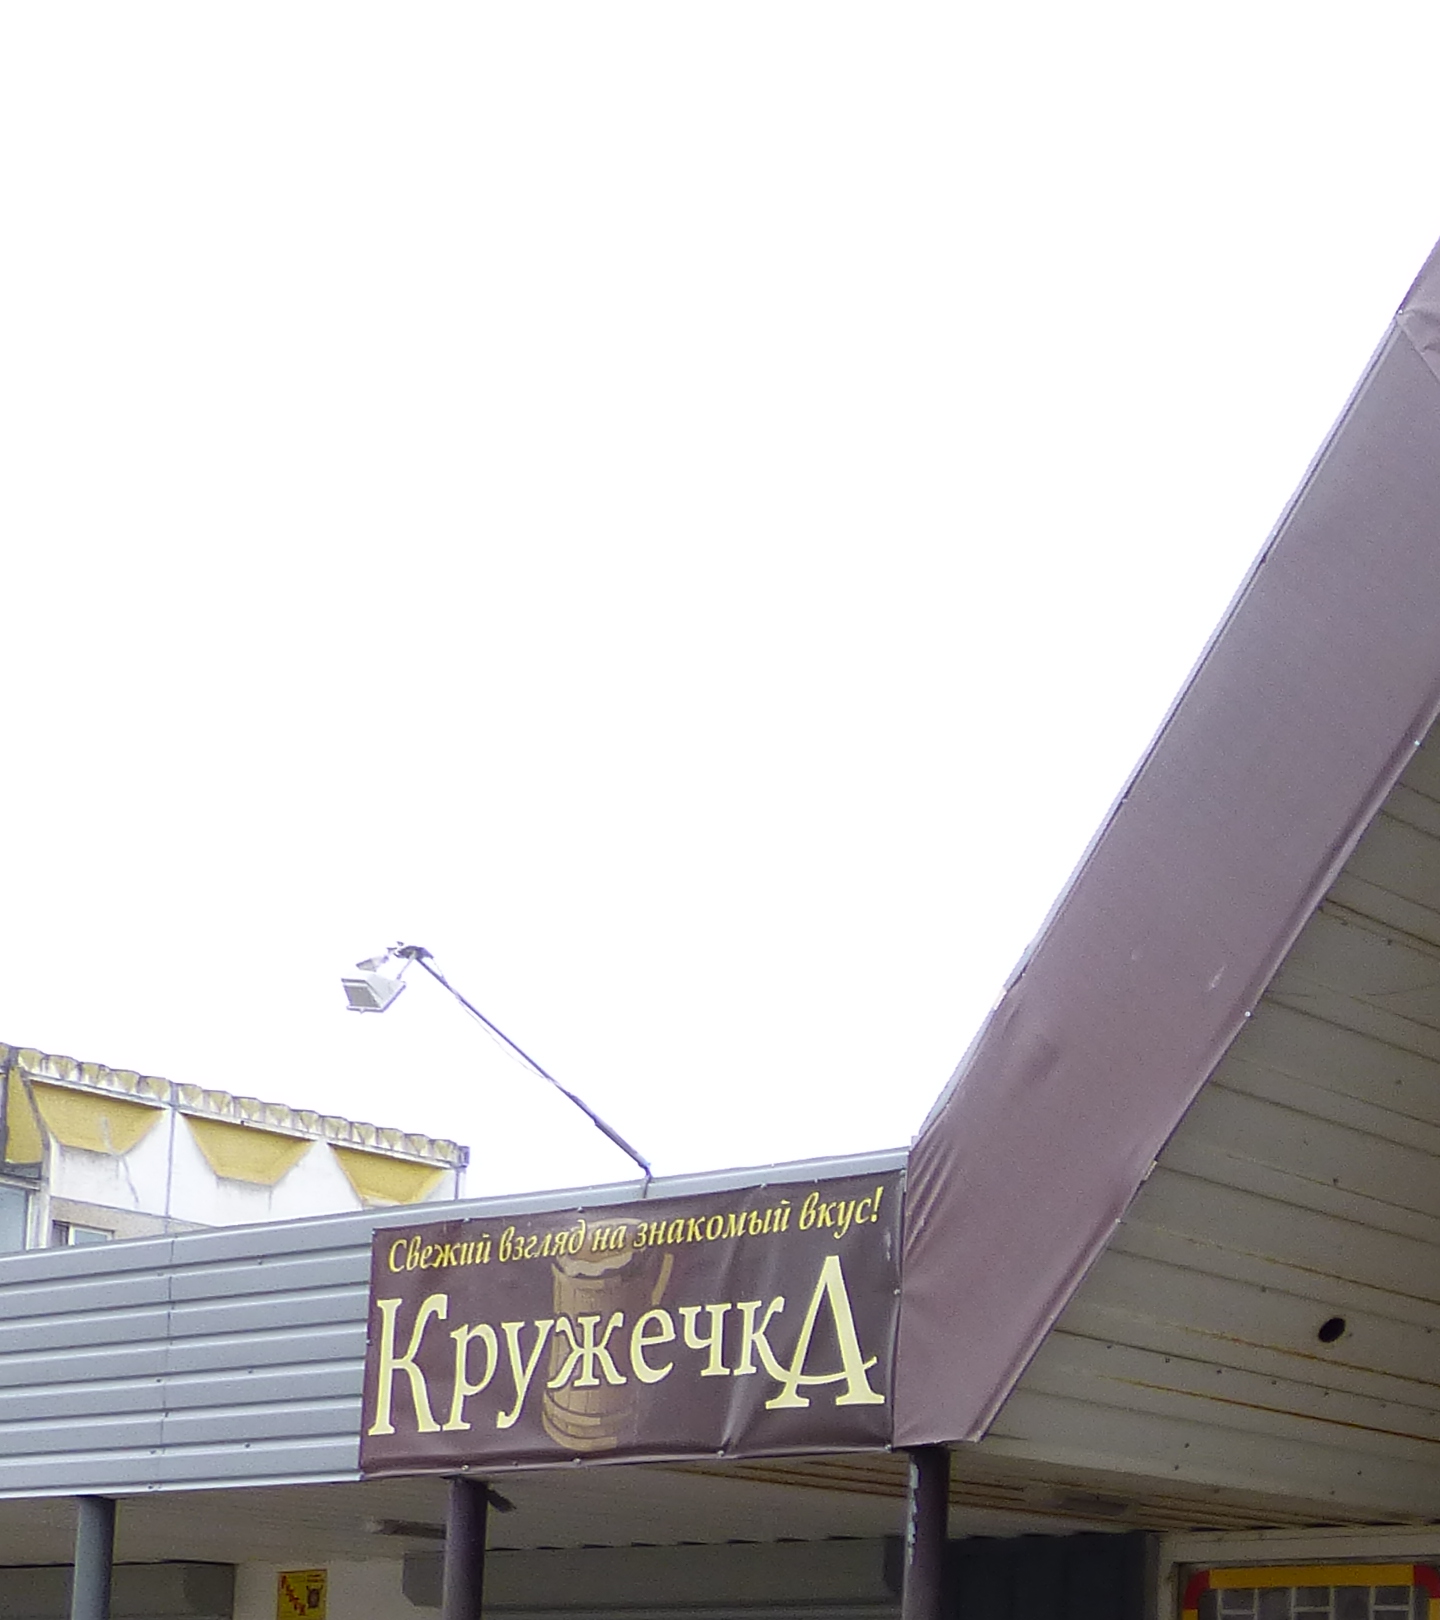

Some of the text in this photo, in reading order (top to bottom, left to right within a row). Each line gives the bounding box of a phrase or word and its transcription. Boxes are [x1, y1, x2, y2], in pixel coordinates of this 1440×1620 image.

[388, 1186, 885, 1274] Свежий взгляд на знакомый вкус!
